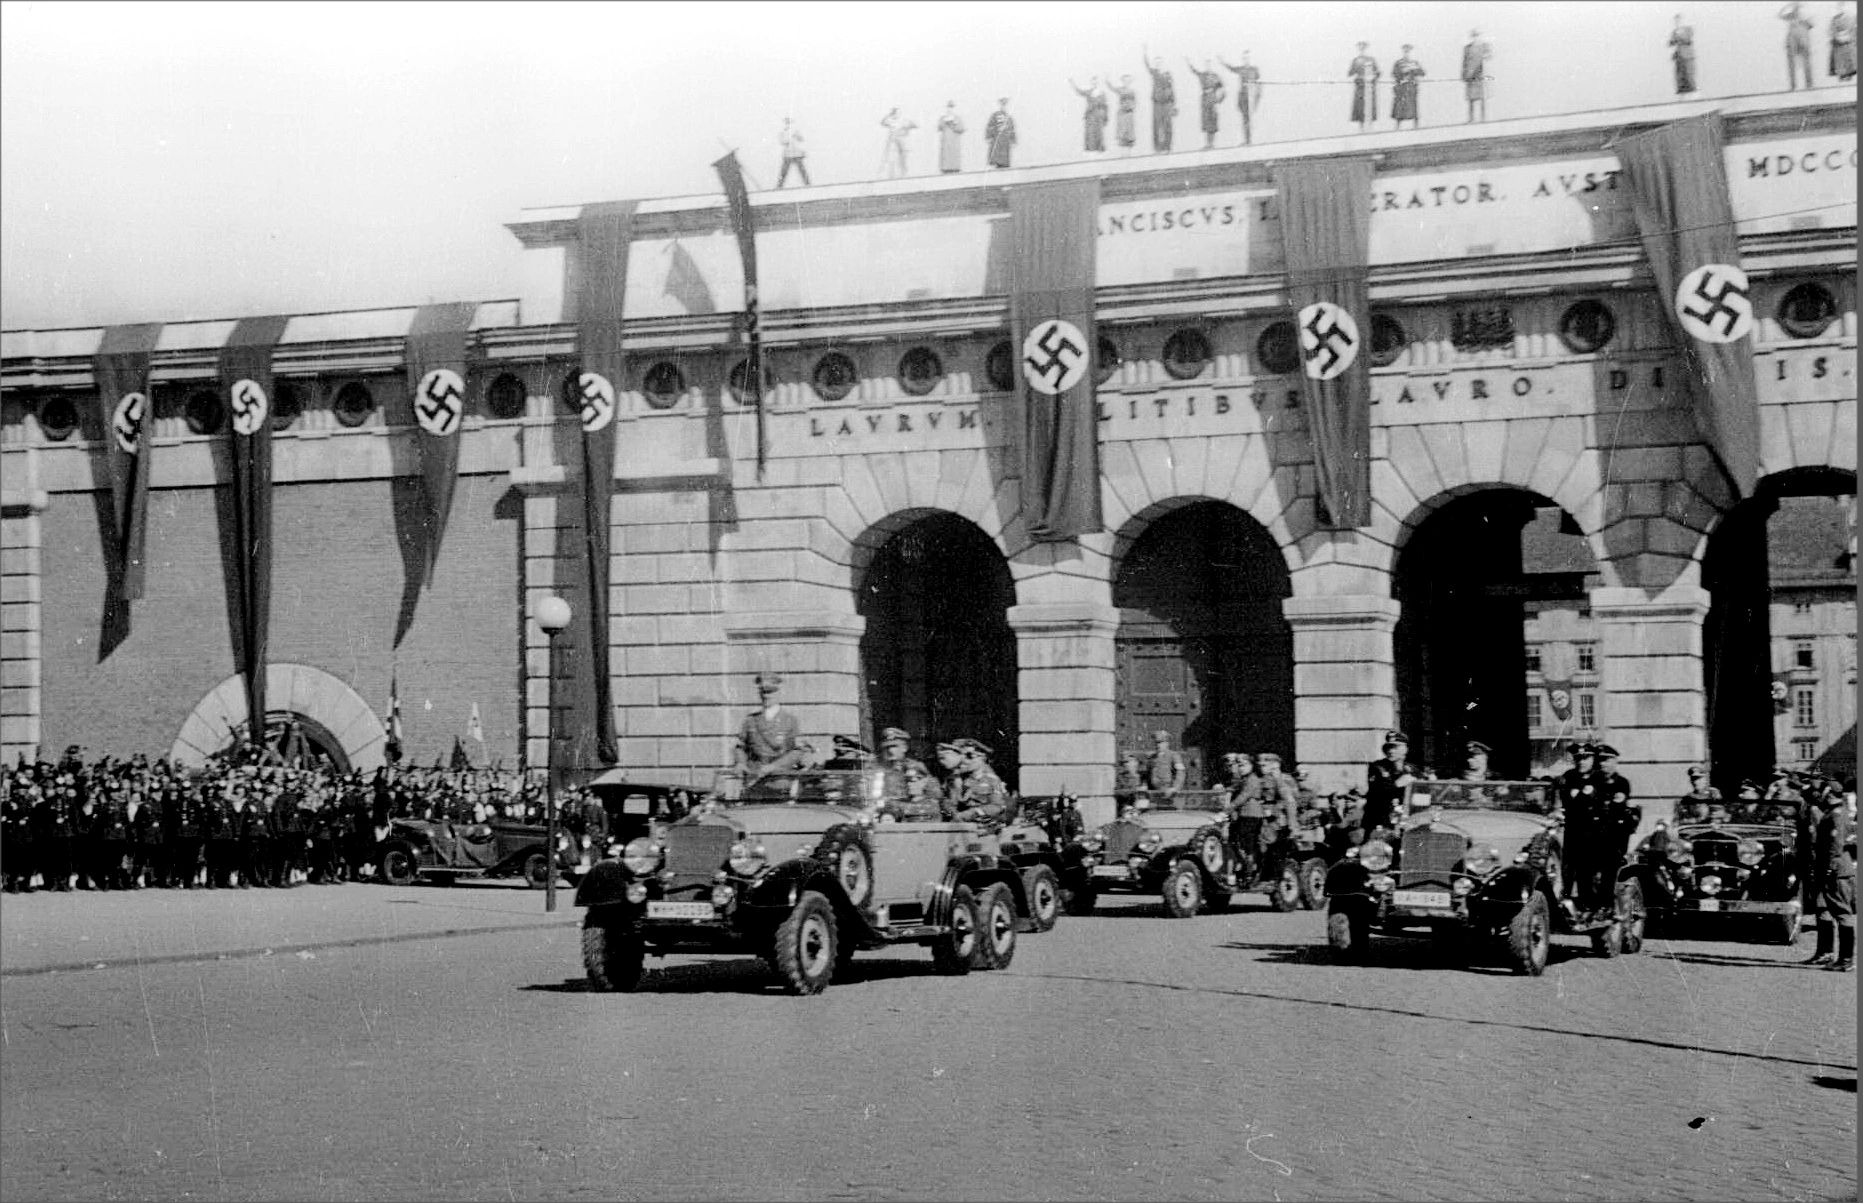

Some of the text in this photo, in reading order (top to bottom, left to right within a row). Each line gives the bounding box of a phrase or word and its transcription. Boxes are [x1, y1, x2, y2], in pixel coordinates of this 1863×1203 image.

[1098, 205, 1244, 236] NCISCVS.
[1532, 169, 1625, 198] AVST
[1097, 389, 1300, 422] LITIBVS
[1369, 376, 1554, 406] AVRO.
